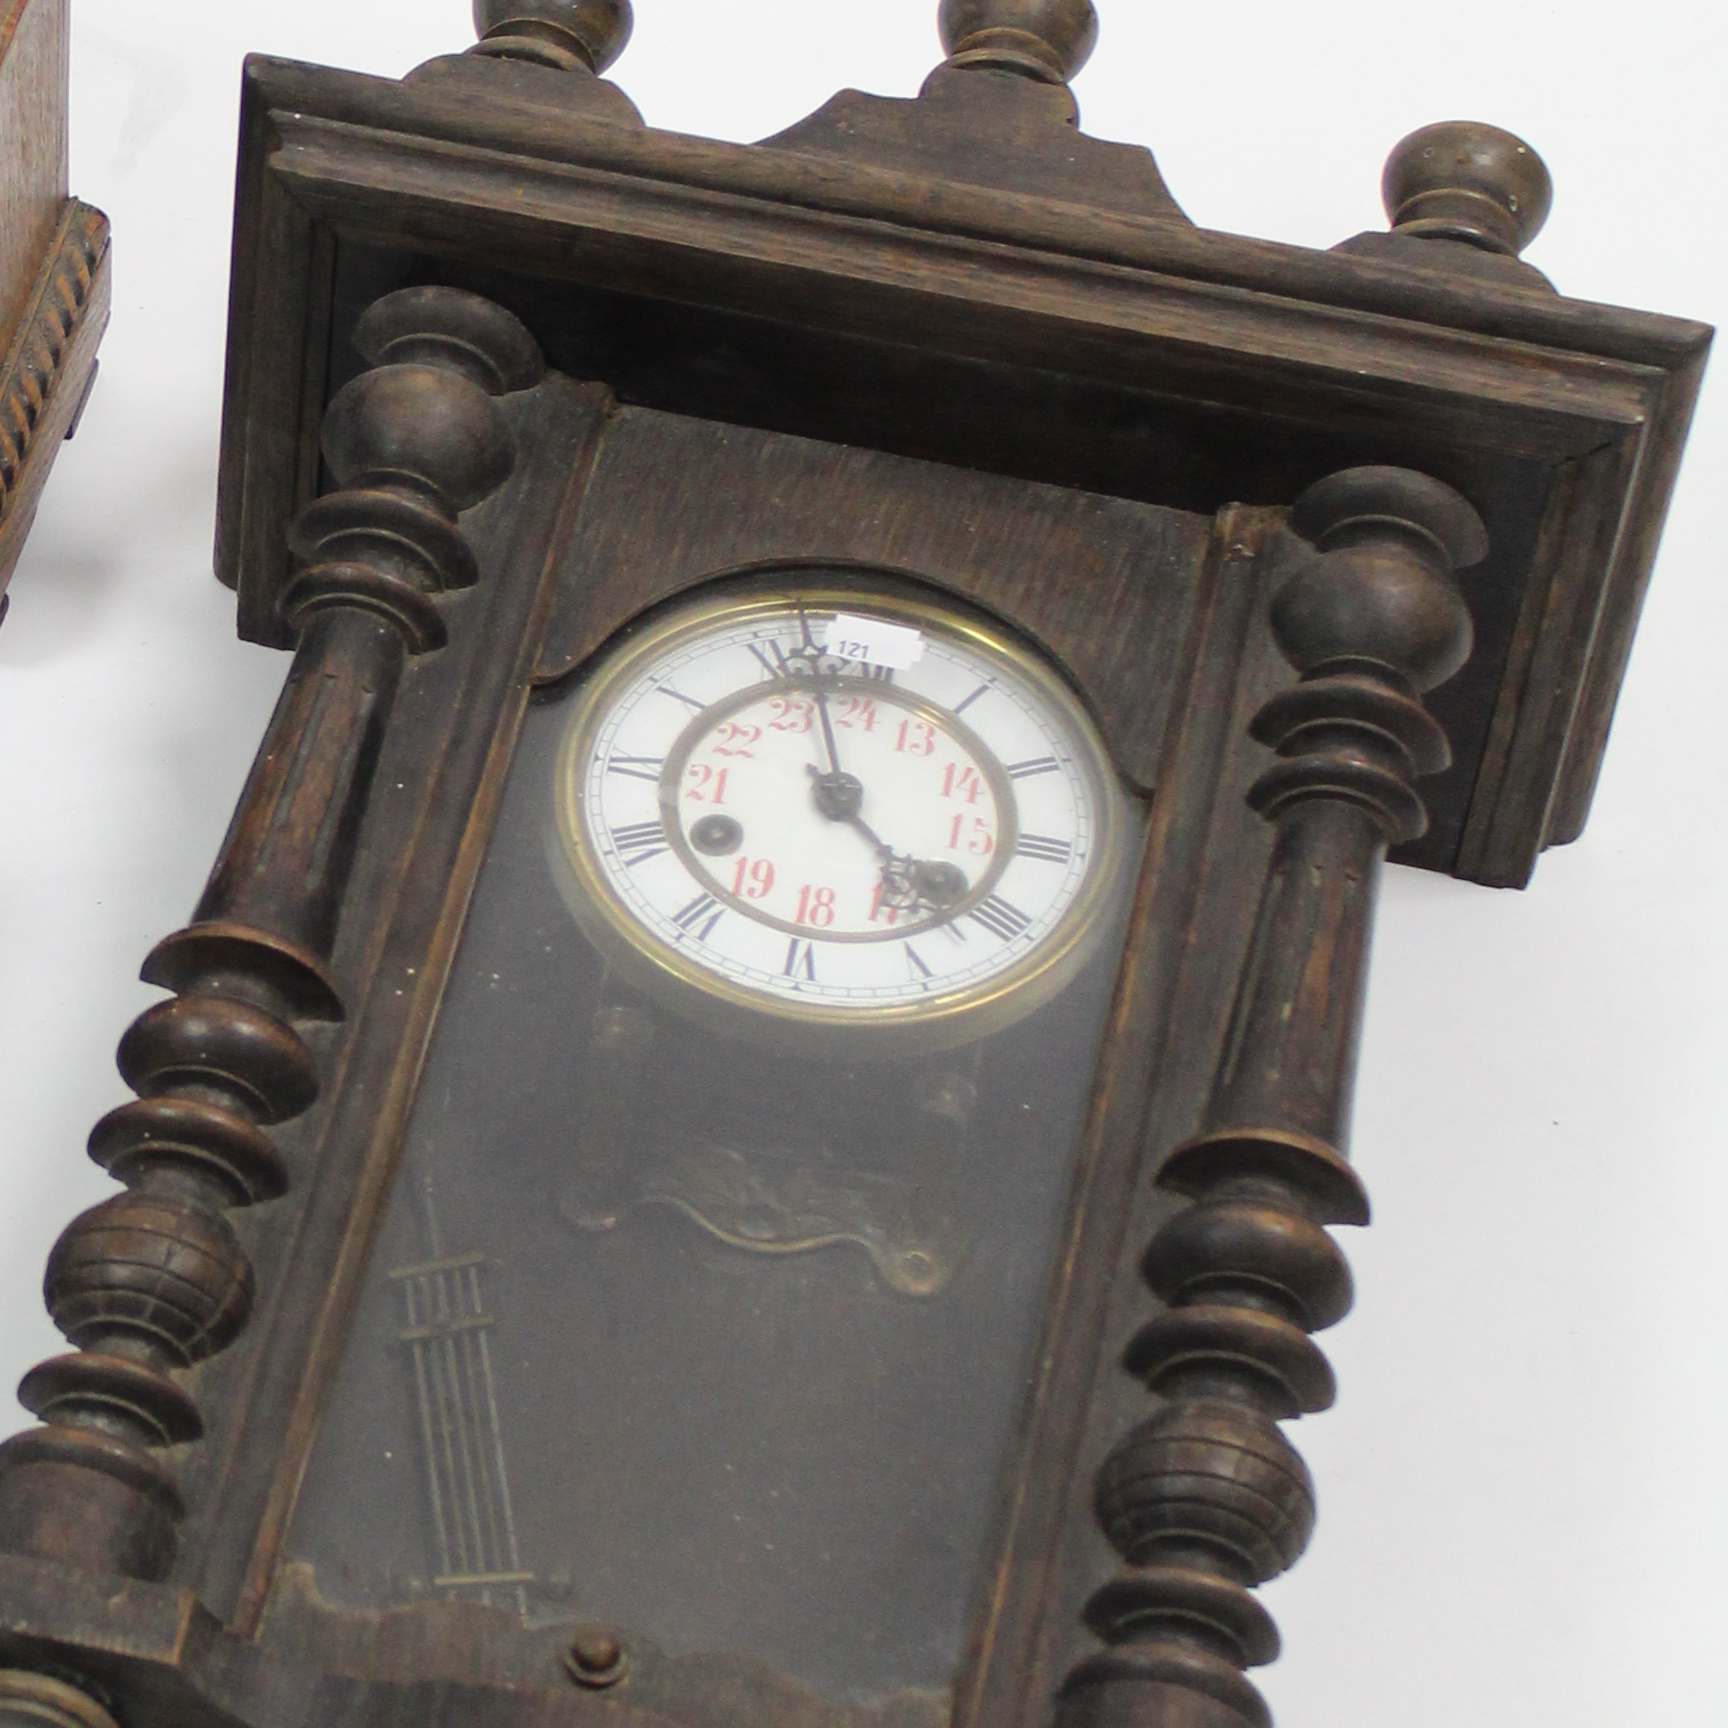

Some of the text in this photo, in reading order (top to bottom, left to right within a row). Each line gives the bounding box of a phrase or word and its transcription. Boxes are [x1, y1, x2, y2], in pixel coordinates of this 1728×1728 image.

[838, 639, 870, 660] 121
[768, 696, 815, 734] 23
[834, 695, 881, 733] 24
[711, 722, 763, 759] 22
[894, 719, 937, 757] 13
[685, 762, 729, 805] 21
[940, 761, 985, 805] 14
[945, 812, 995, 856] 15
[731, 854, 777, 900] 19
[794, 883, 837, 929] 18
